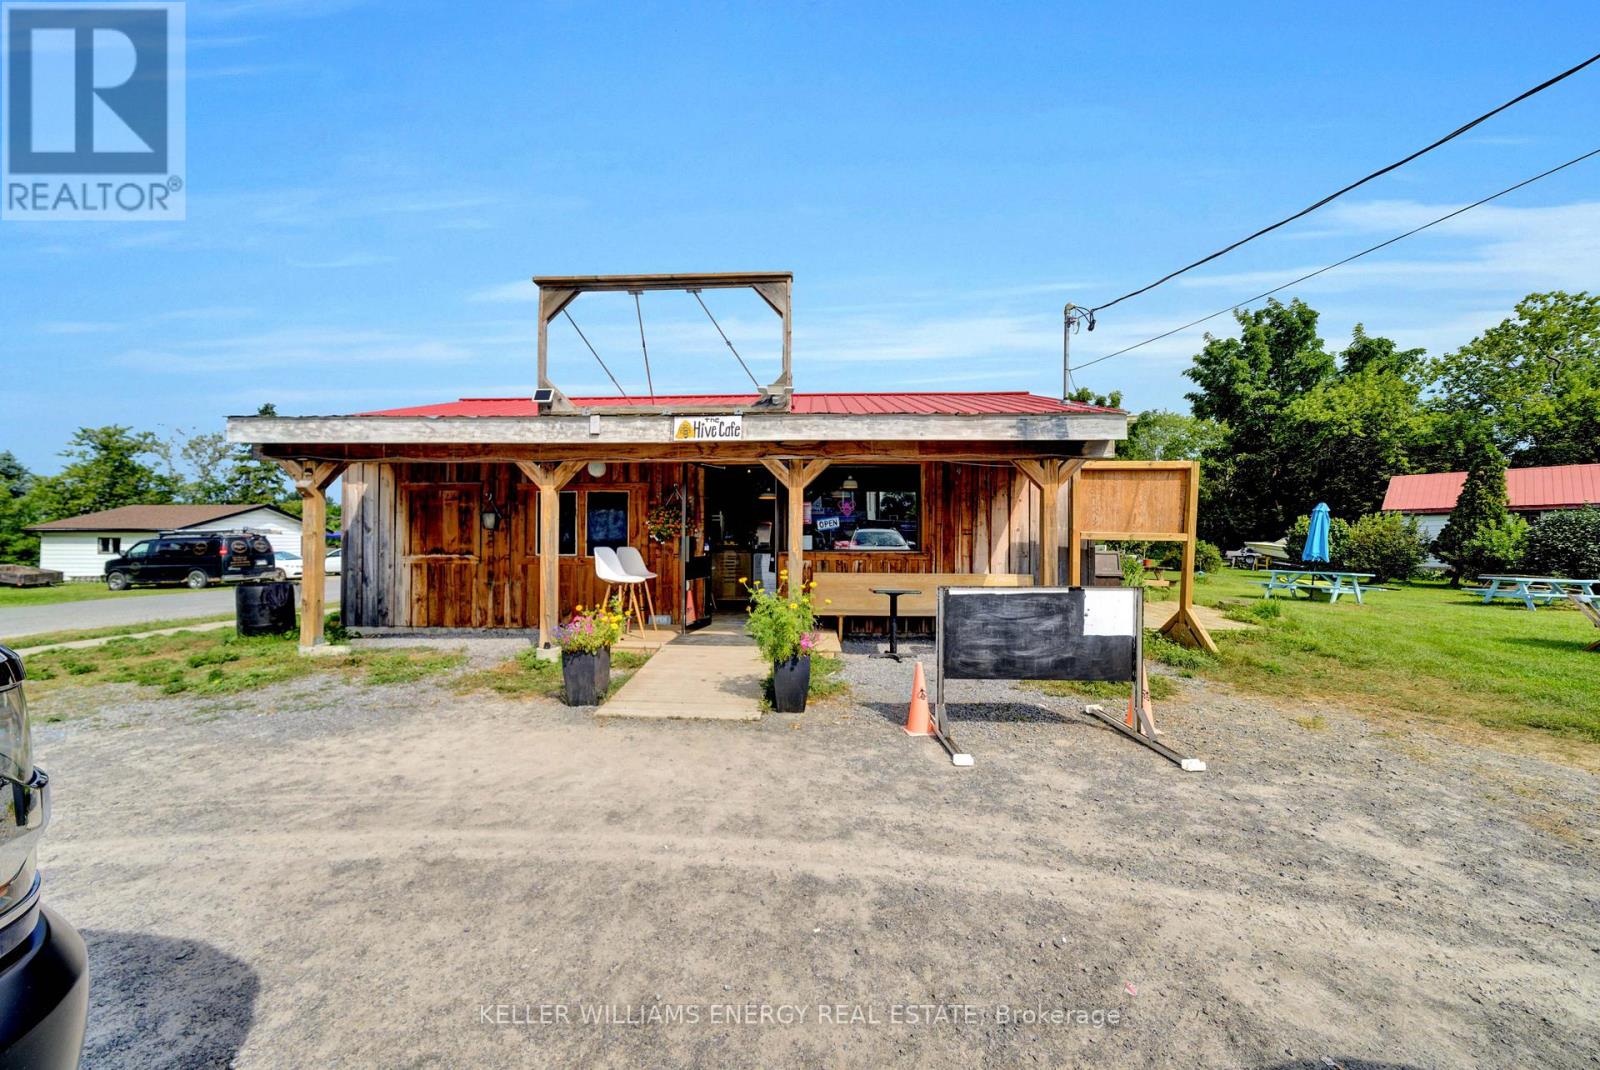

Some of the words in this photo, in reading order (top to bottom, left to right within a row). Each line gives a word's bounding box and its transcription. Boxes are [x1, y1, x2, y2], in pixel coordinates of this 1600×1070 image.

[693, 420, 717, 438] Hive
[718, 421, 741, 437] Cafe
[818, 519, 838, 528] OPEN
